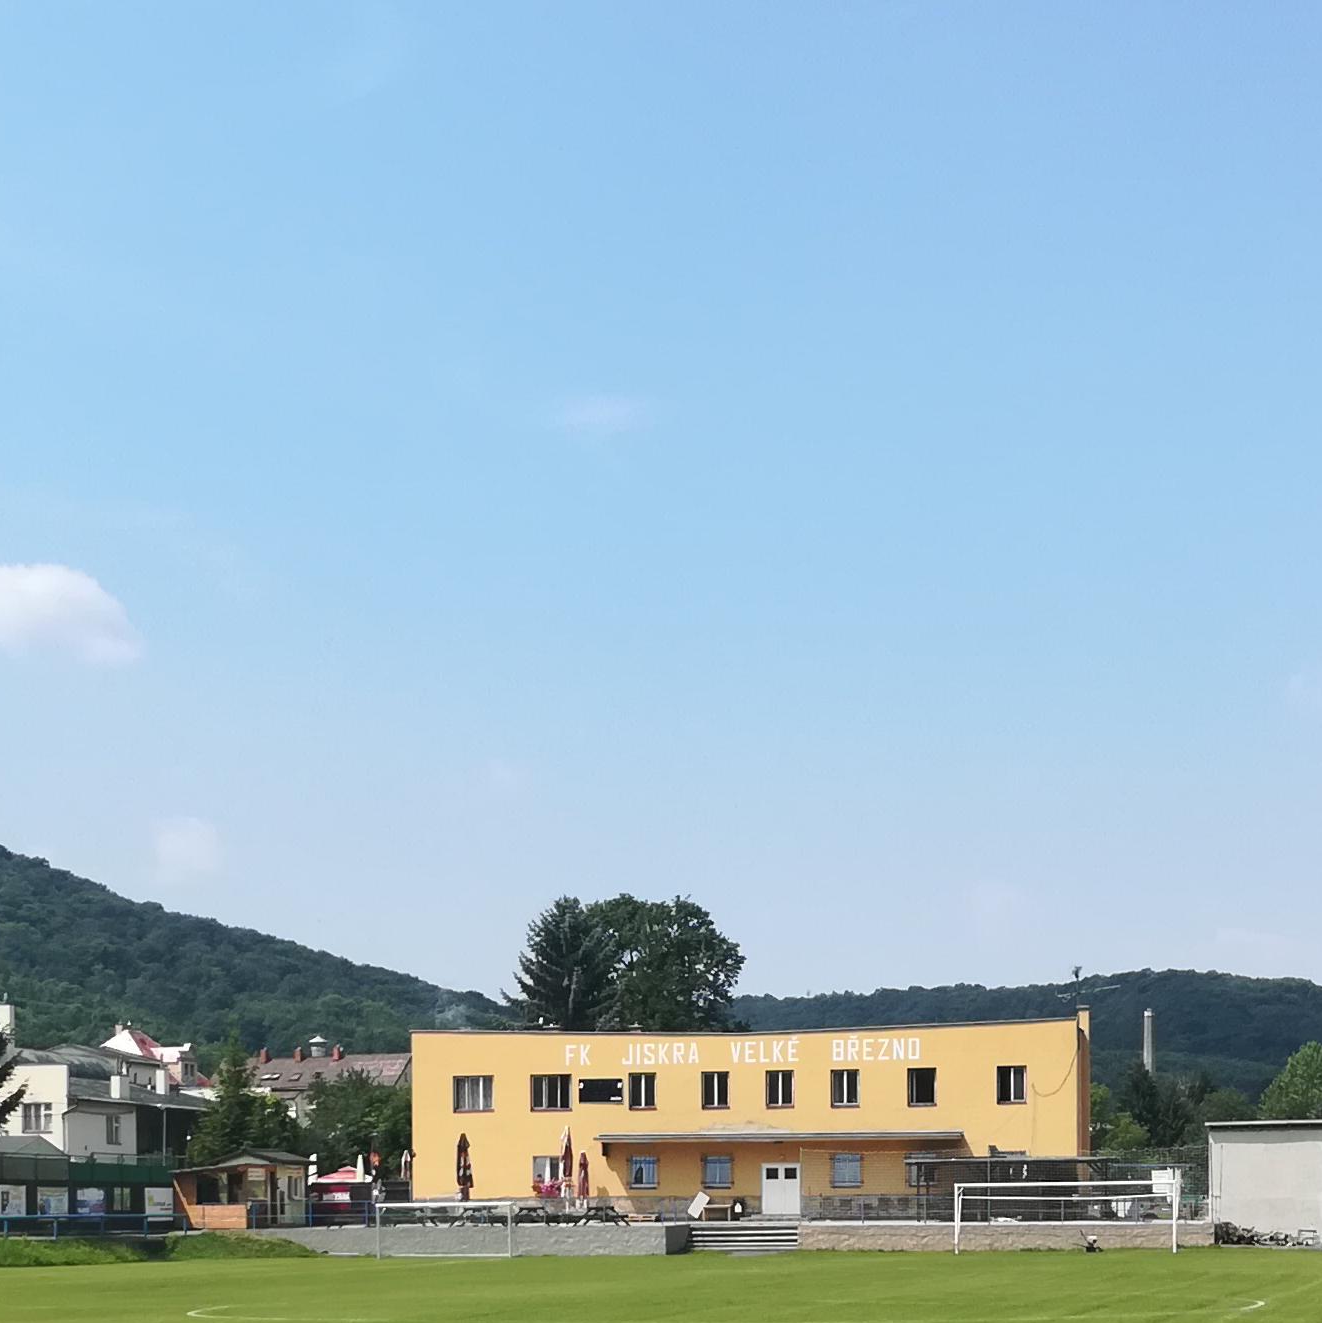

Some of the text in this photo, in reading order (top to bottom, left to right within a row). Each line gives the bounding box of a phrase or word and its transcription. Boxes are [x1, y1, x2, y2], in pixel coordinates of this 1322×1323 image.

[565, 1035, 921, 1066] FK JISKRA VELKÉ BŘEZNO
